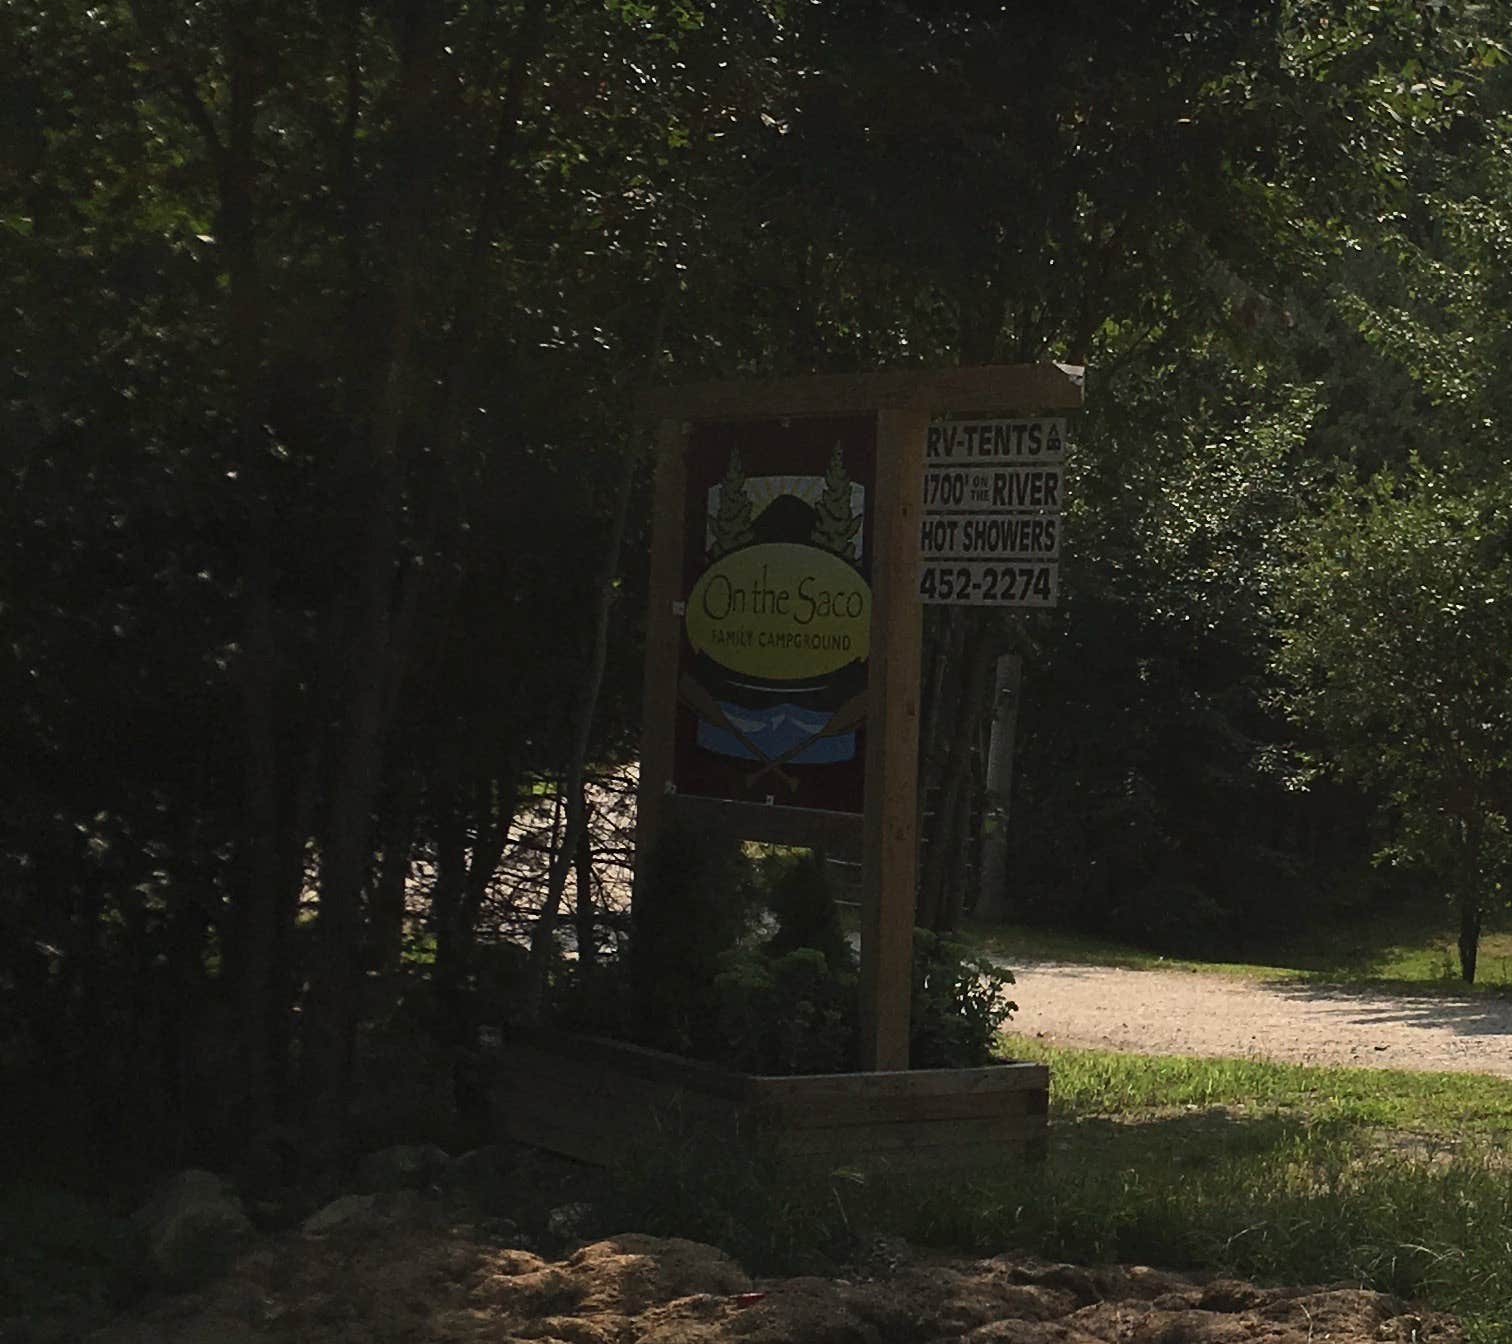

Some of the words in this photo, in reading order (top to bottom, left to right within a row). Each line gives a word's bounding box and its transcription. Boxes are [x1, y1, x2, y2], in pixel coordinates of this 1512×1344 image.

[927, 423, 1042, 457] RV-TENTS
[971, 489, 990, 502] THE
[972, 476, 988, 487] ON
[992, 472, 1058, 506] RIVER
[921, 520, 957, 551] HOT
[963, 520, 1056, 552] SHOWERS
[703, 574, 745, 620] On
[752, 564, 790, 615] the
[794, 576, 864, 624] Saco
[920, 567, 1052, 600] 452-2274
[711, 628, 752, 646] FAMILY
[759, 631, 851, 651] CAMPGROUND
